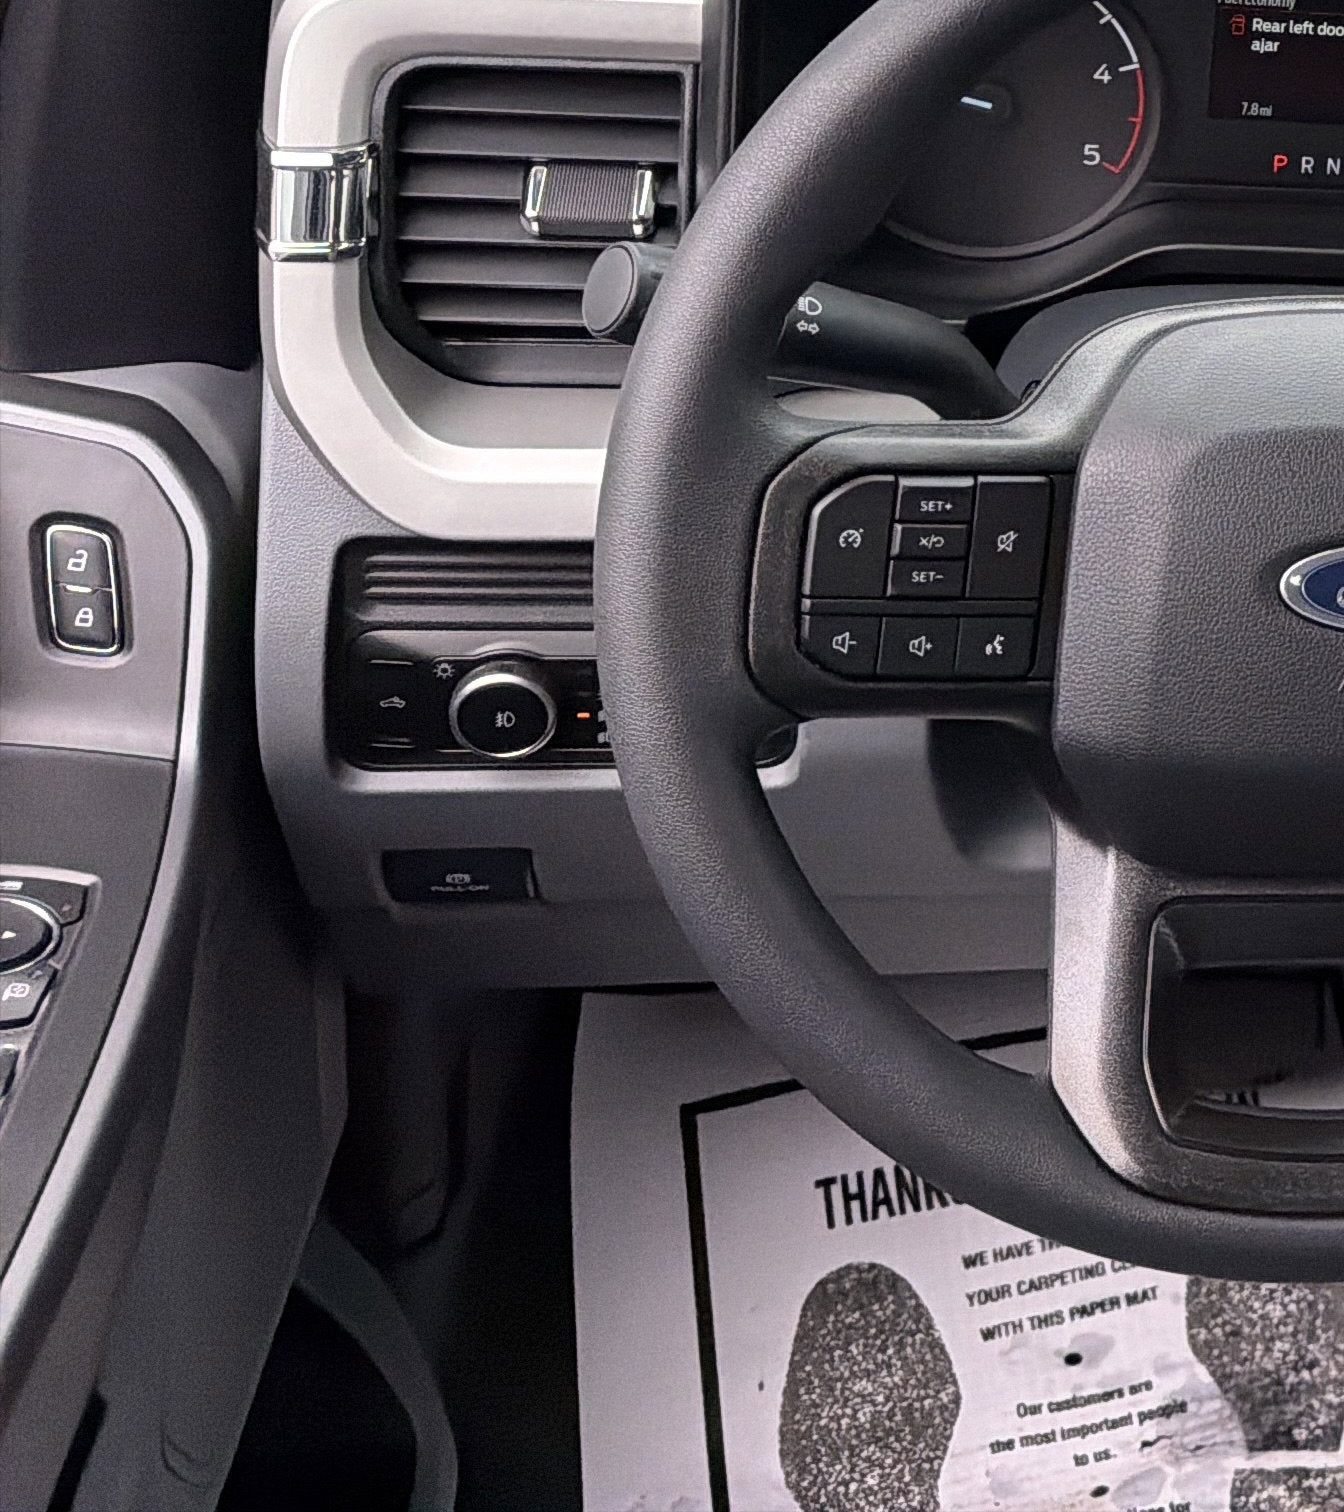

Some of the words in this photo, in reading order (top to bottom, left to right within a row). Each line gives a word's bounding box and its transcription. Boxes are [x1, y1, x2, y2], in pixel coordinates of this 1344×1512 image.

[1251, 17, 1287, 34] Rear
[1289, 19, 1314, 36] left
[1250, 37, 1281, 54] ajar
[1093, 63, 1113, 85] 4
[1082, 144, 1101, 167] 5
[1272, 154, 1288, 174] P
[1301, 156, 1315, 175] R
[1326, 158, 1342, 177] N
[919, 499, 953, 513] SET+
[961, 1249, 989, 1270] WE
[992, 1238, 1034, 1264] HAVE
[965, 1283, 1013, 1307] YOUR
[1016, 1260, 1106, 1296] CARPETING
[979, 1318, 1024, 1342] WITH
[1028, 1309, 1065, 1331] THIS
[1068, 1297, 1122, 1322] PAPER
[1124, 1285, 1159, 1308] MAT
[1016, 1401, 1043, 1419] Our
[1047, 1386, 1125, 1414] customers
[1128, 1379, 1153, 1396] are
[989, 1437, 1016, 1455] the
[1019, 1428, 1058, 1448] most
[1060, 1411, 1134, 1441] important
[1137, 1399, 1189, 1427] people
[1072, 1452, 1090, 1467] to
